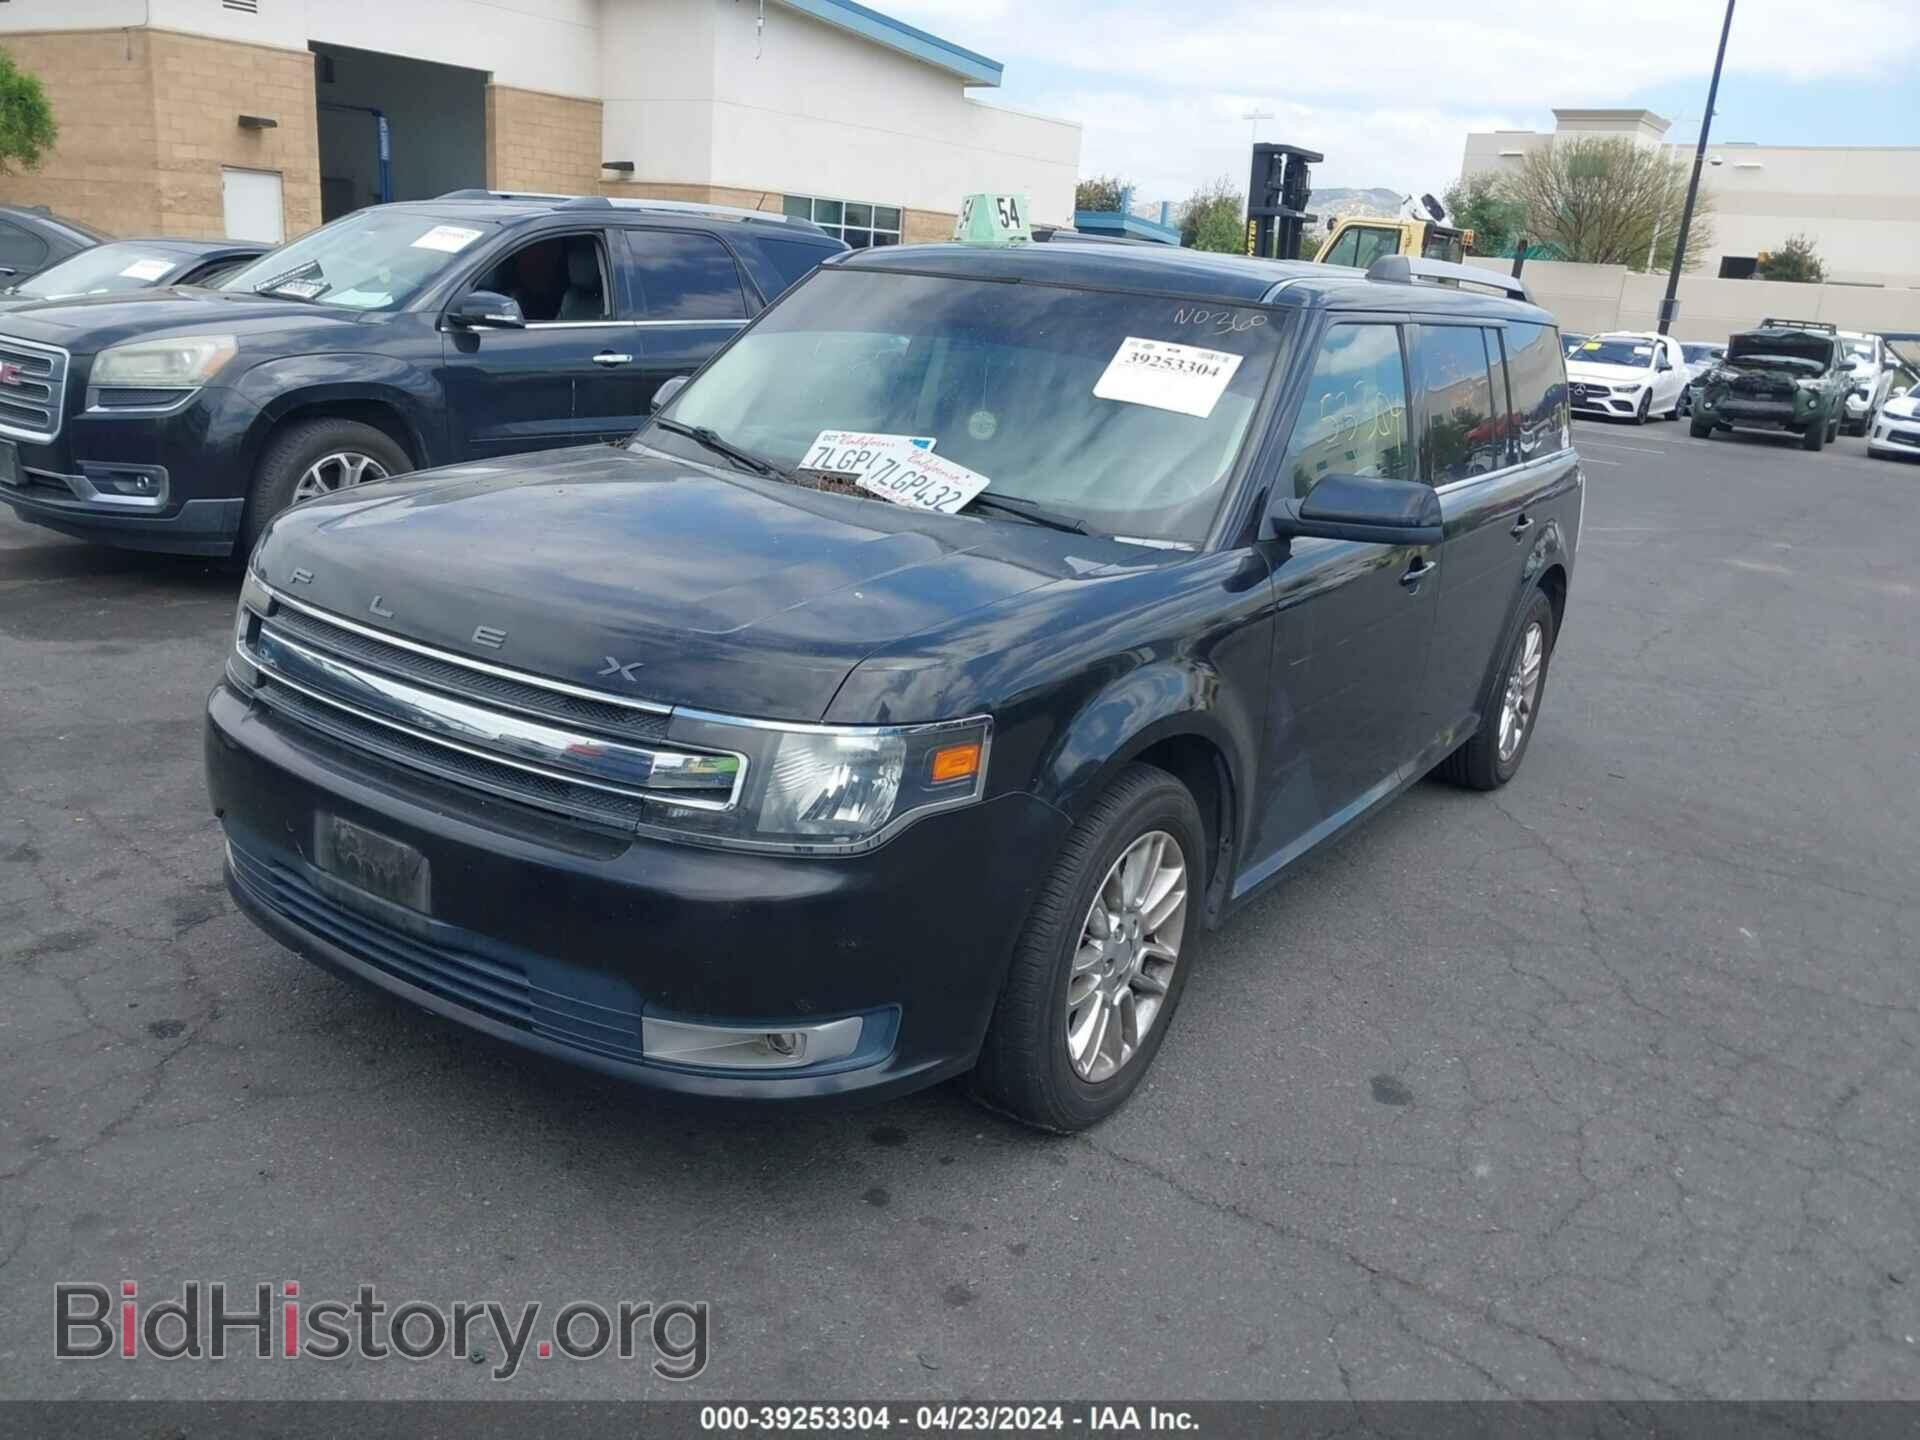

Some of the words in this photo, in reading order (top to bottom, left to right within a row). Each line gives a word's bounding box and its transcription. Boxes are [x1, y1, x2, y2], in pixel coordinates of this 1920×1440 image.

[996, 197, 1021, 229] 54
[1125, 351, 1221, 377] 39253304
[871, 458, 963, 513] 7LGP432
[290, 567, 645, 682] FLEX
